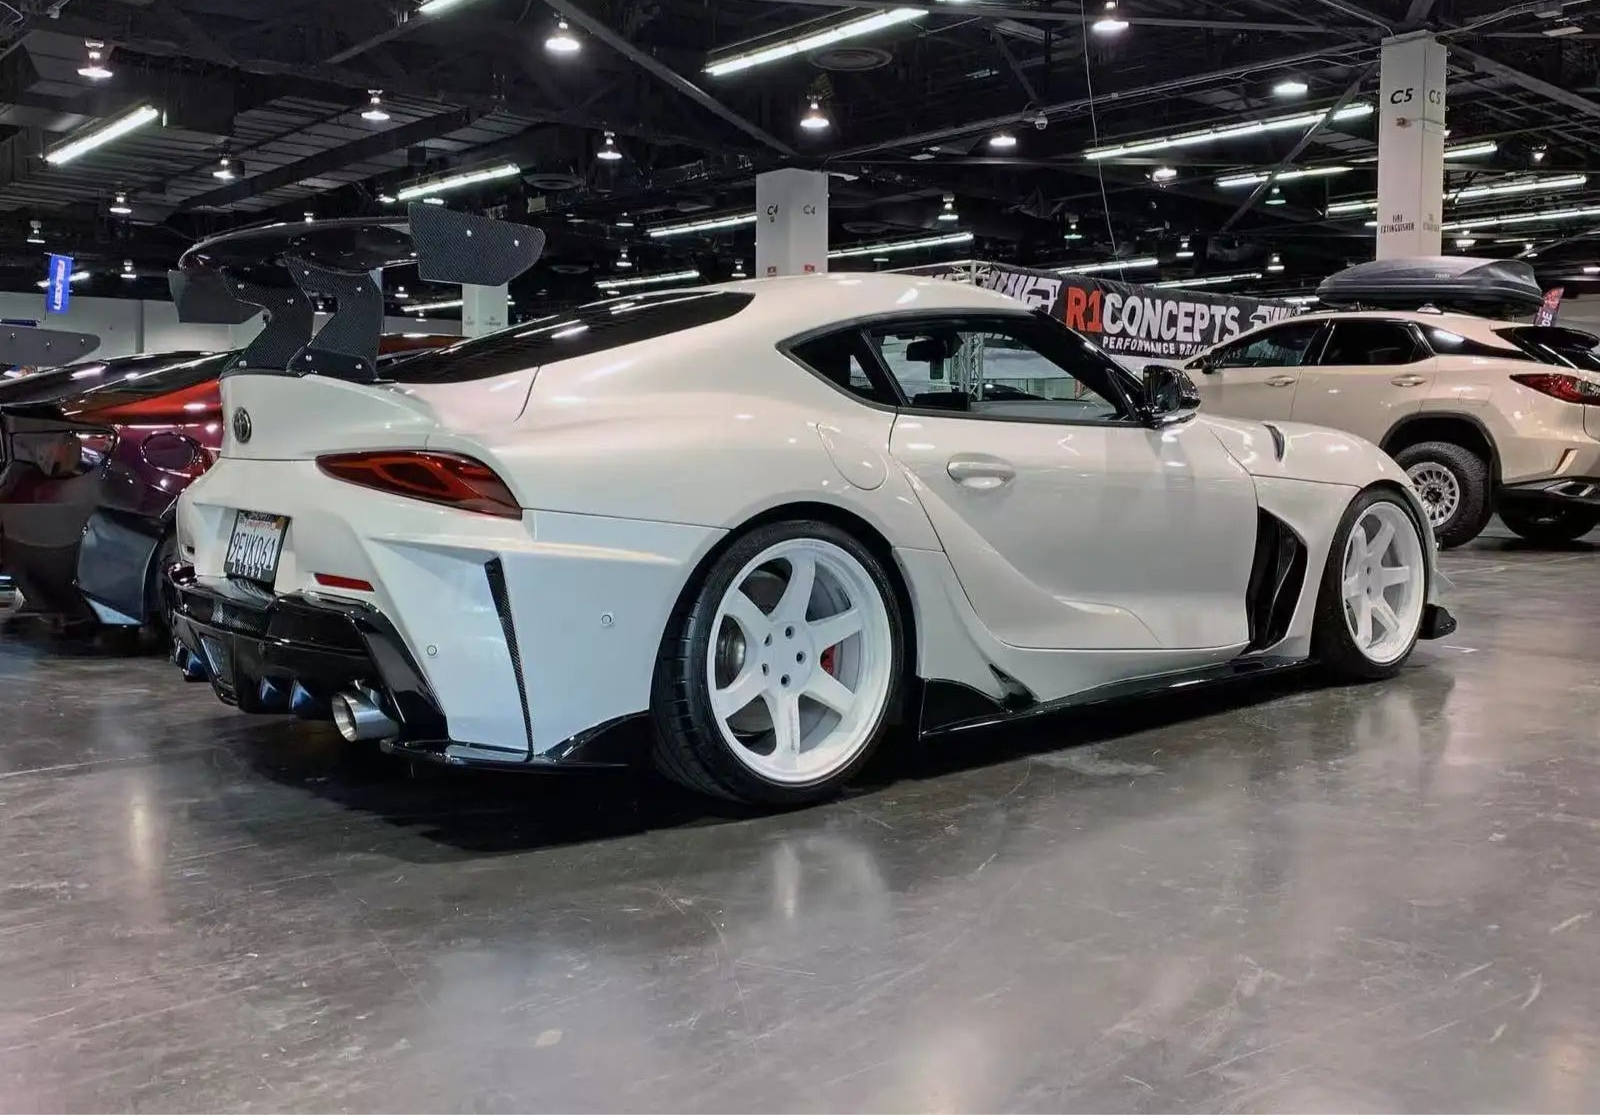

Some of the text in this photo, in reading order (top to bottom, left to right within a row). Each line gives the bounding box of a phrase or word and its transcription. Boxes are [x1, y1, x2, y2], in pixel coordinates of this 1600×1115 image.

[1390, 88, 1413, 104] C5
[767, 204, 778, 215] C4
[803, 204, 816, 216] C4
[1102, 335, 1175, 354] PERFORMANCE
[229, 531, 277, 570] 9EVK061
